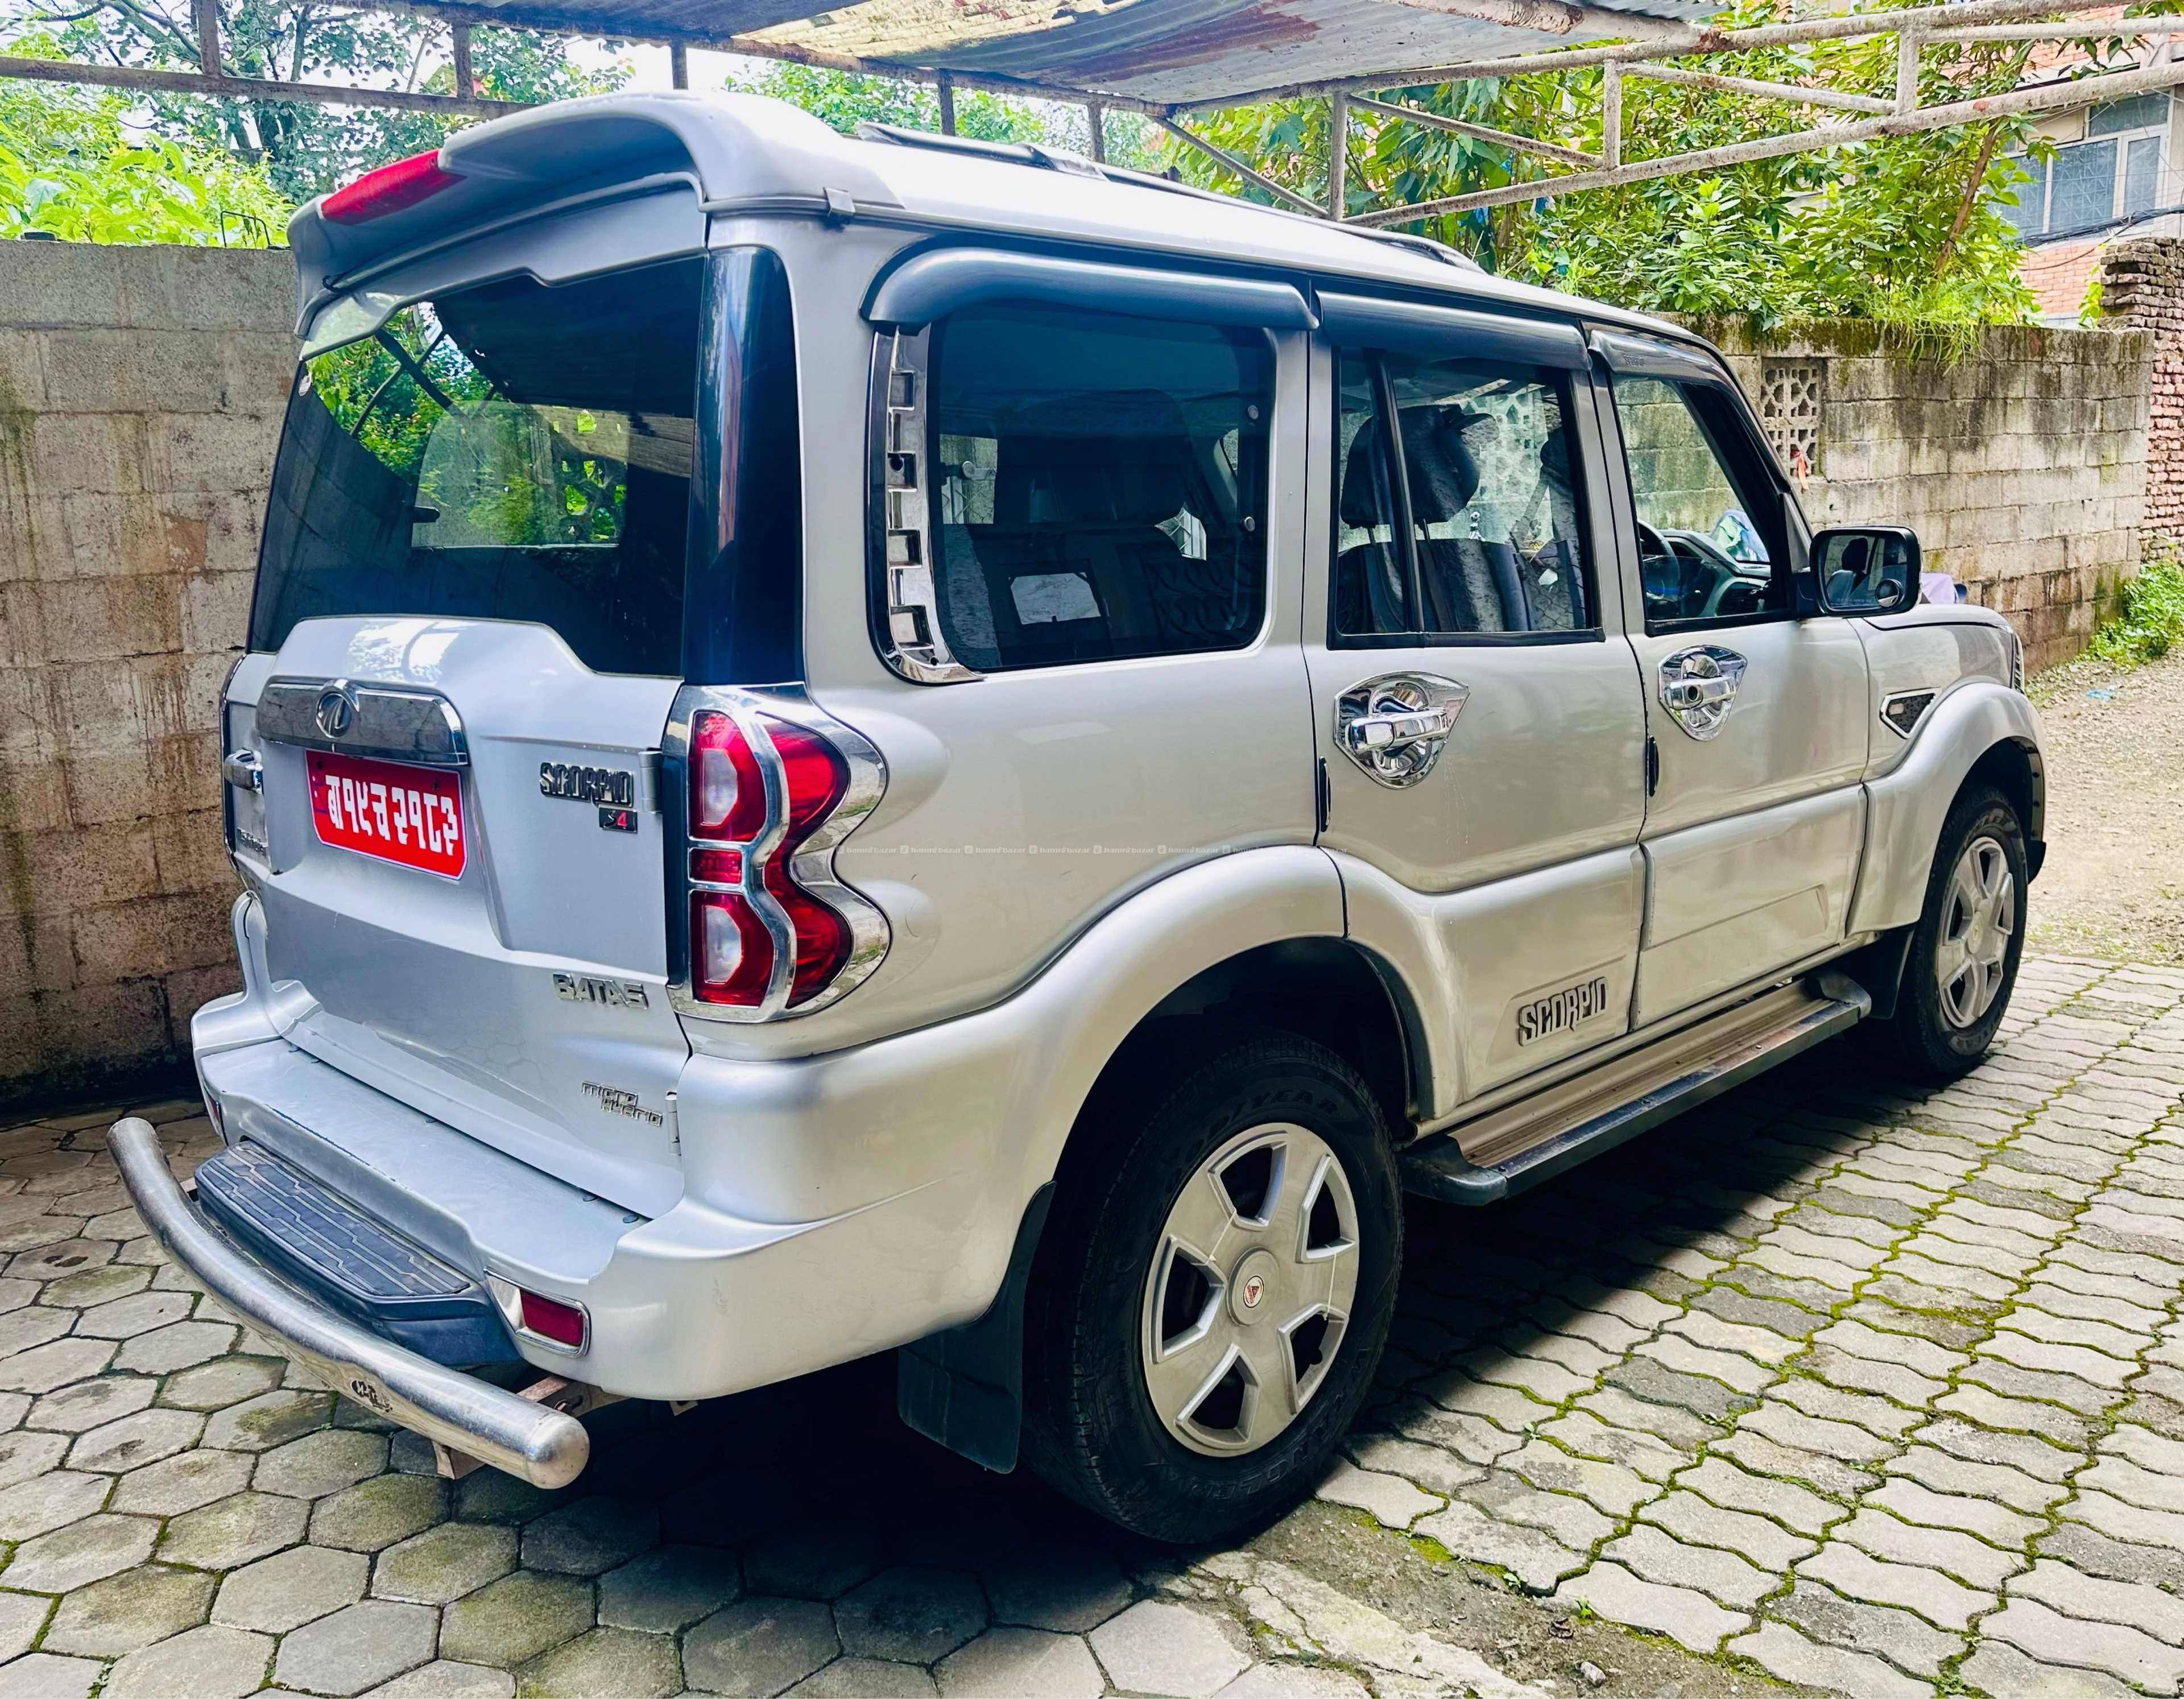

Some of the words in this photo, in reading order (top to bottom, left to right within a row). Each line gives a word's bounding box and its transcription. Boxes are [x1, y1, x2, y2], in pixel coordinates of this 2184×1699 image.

[539, 762, 634, 808] SCORPIO
[601, 809, 628, 829] S4
[553, 972, 649, 1010] BATAS
[1519, 976, 1608, 1047] SCORPIO
